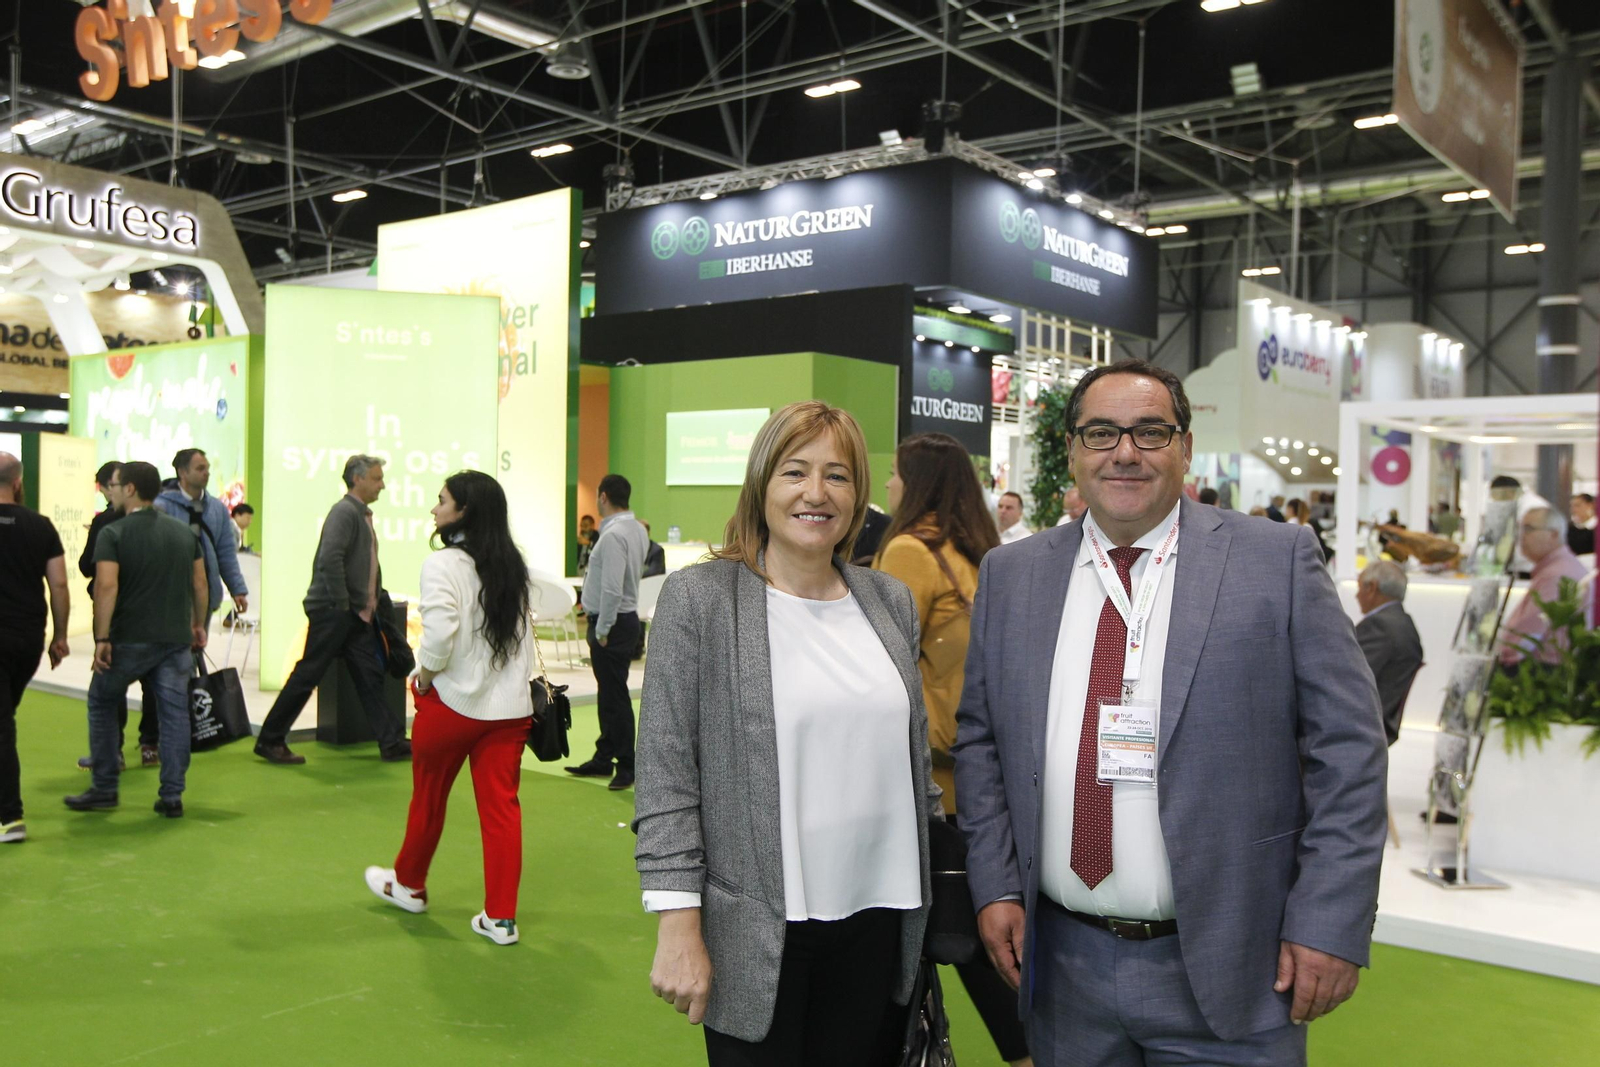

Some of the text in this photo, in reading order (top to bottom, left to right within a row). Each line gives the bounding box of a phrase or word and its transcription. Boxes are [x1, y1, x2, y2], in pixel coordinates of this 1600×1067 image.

[1, 171, 197, 247] Grufesa
[713, 204, 874, 248] NATURGREEN
[726, 248, 814, 276] IBERHANSE
[365, 404, 401, 438] In
[54, 503, 83, 523] Better
